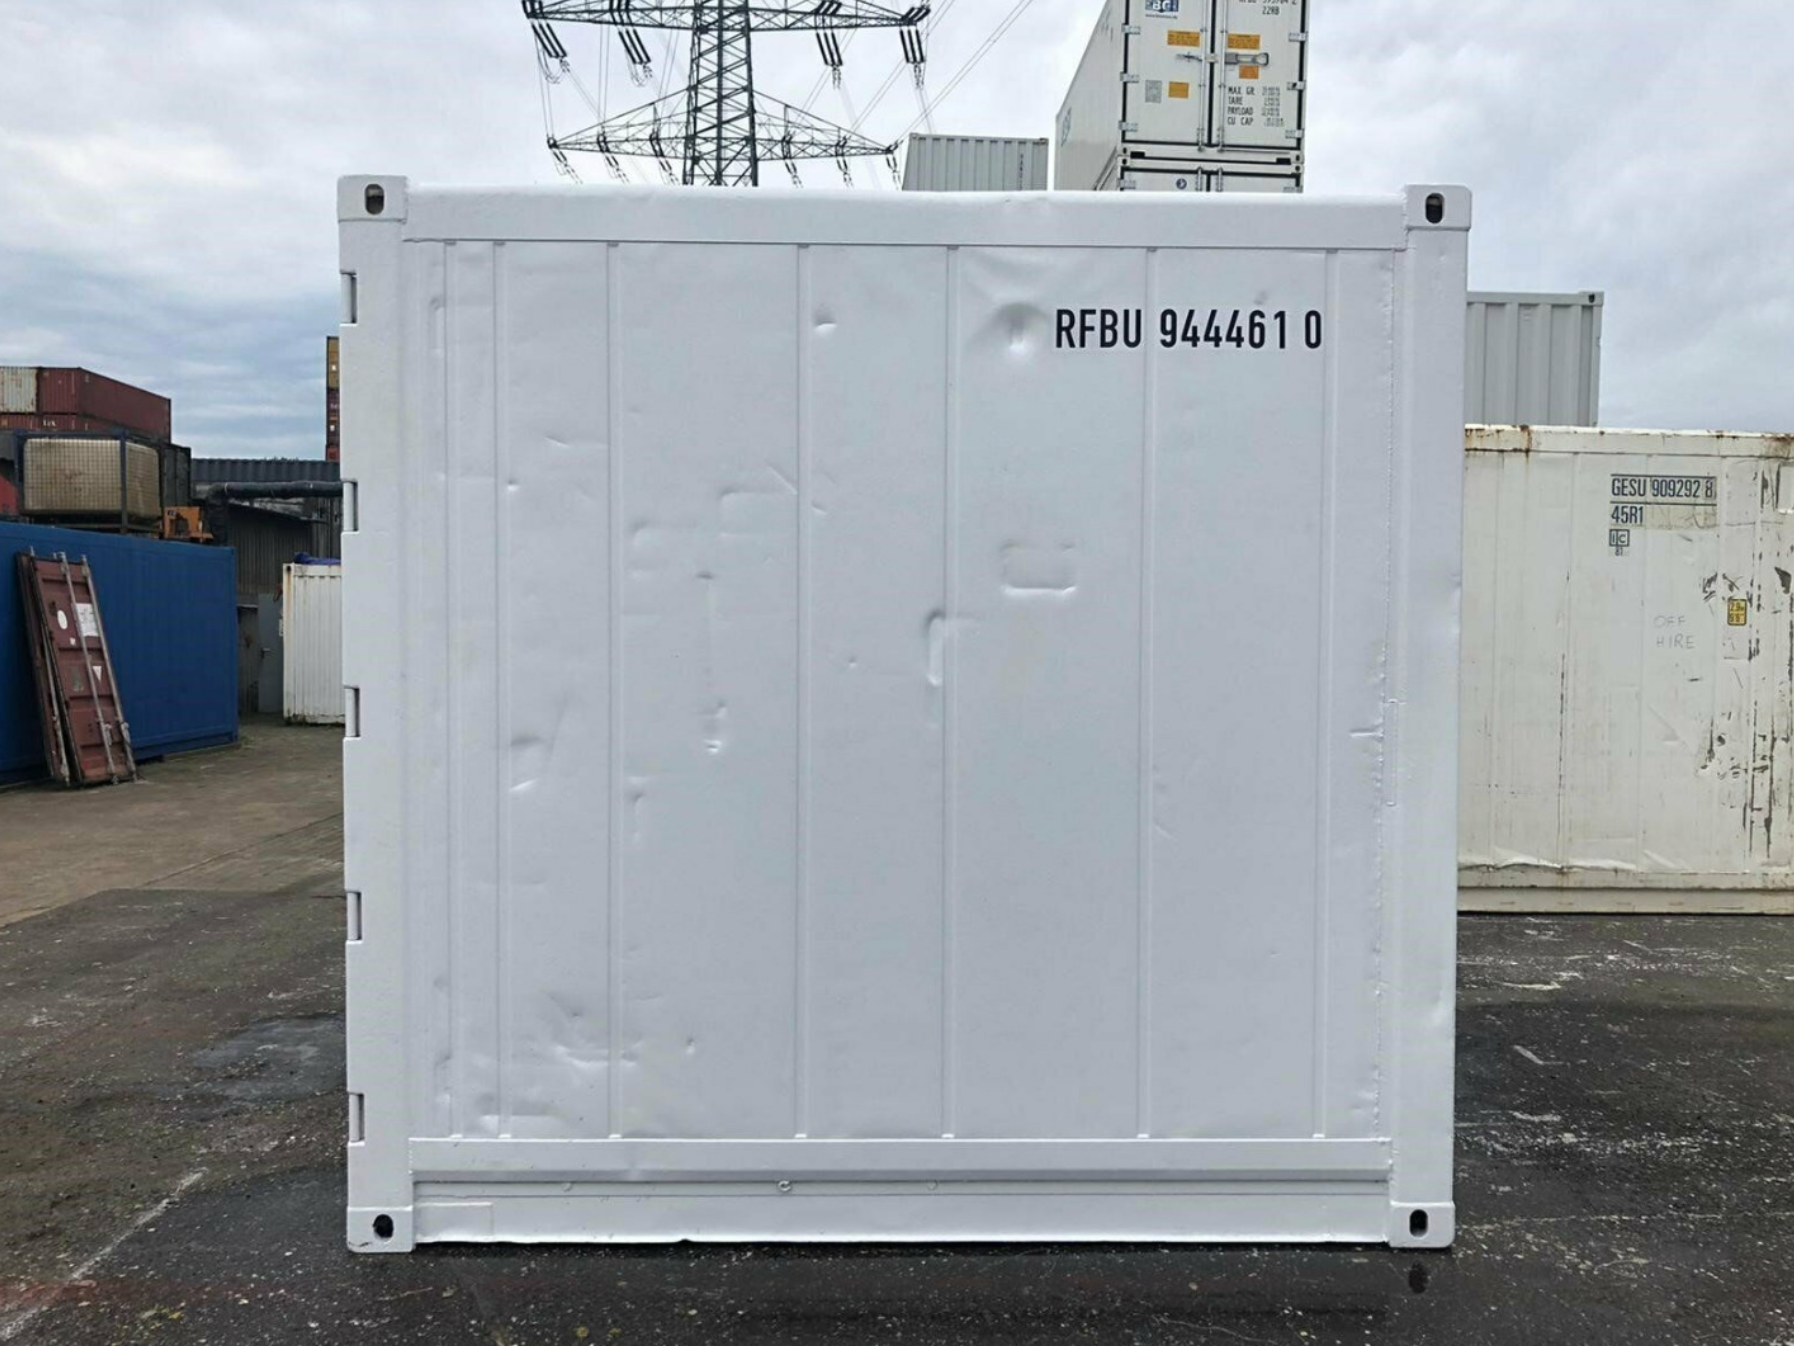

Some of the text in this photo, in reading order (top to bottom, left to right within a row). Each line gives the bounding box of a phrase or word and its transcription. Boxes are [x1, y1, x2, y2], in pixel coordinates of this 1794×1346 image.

[1228, 96, 1243, 105] TARE
[1227, 106, 1254, 116] PAYLOAD
[1055, 308, 1322, 350] RFBU 944461 0
[1611, 477, 1647, 497] GESU
[1651, 478, 1701, 498] 909292
[1611, 505, 1644, 524] 45R1
[1653, 614, 1686, 629] OFF
[1656, 632, 1696, 650] HIRE
